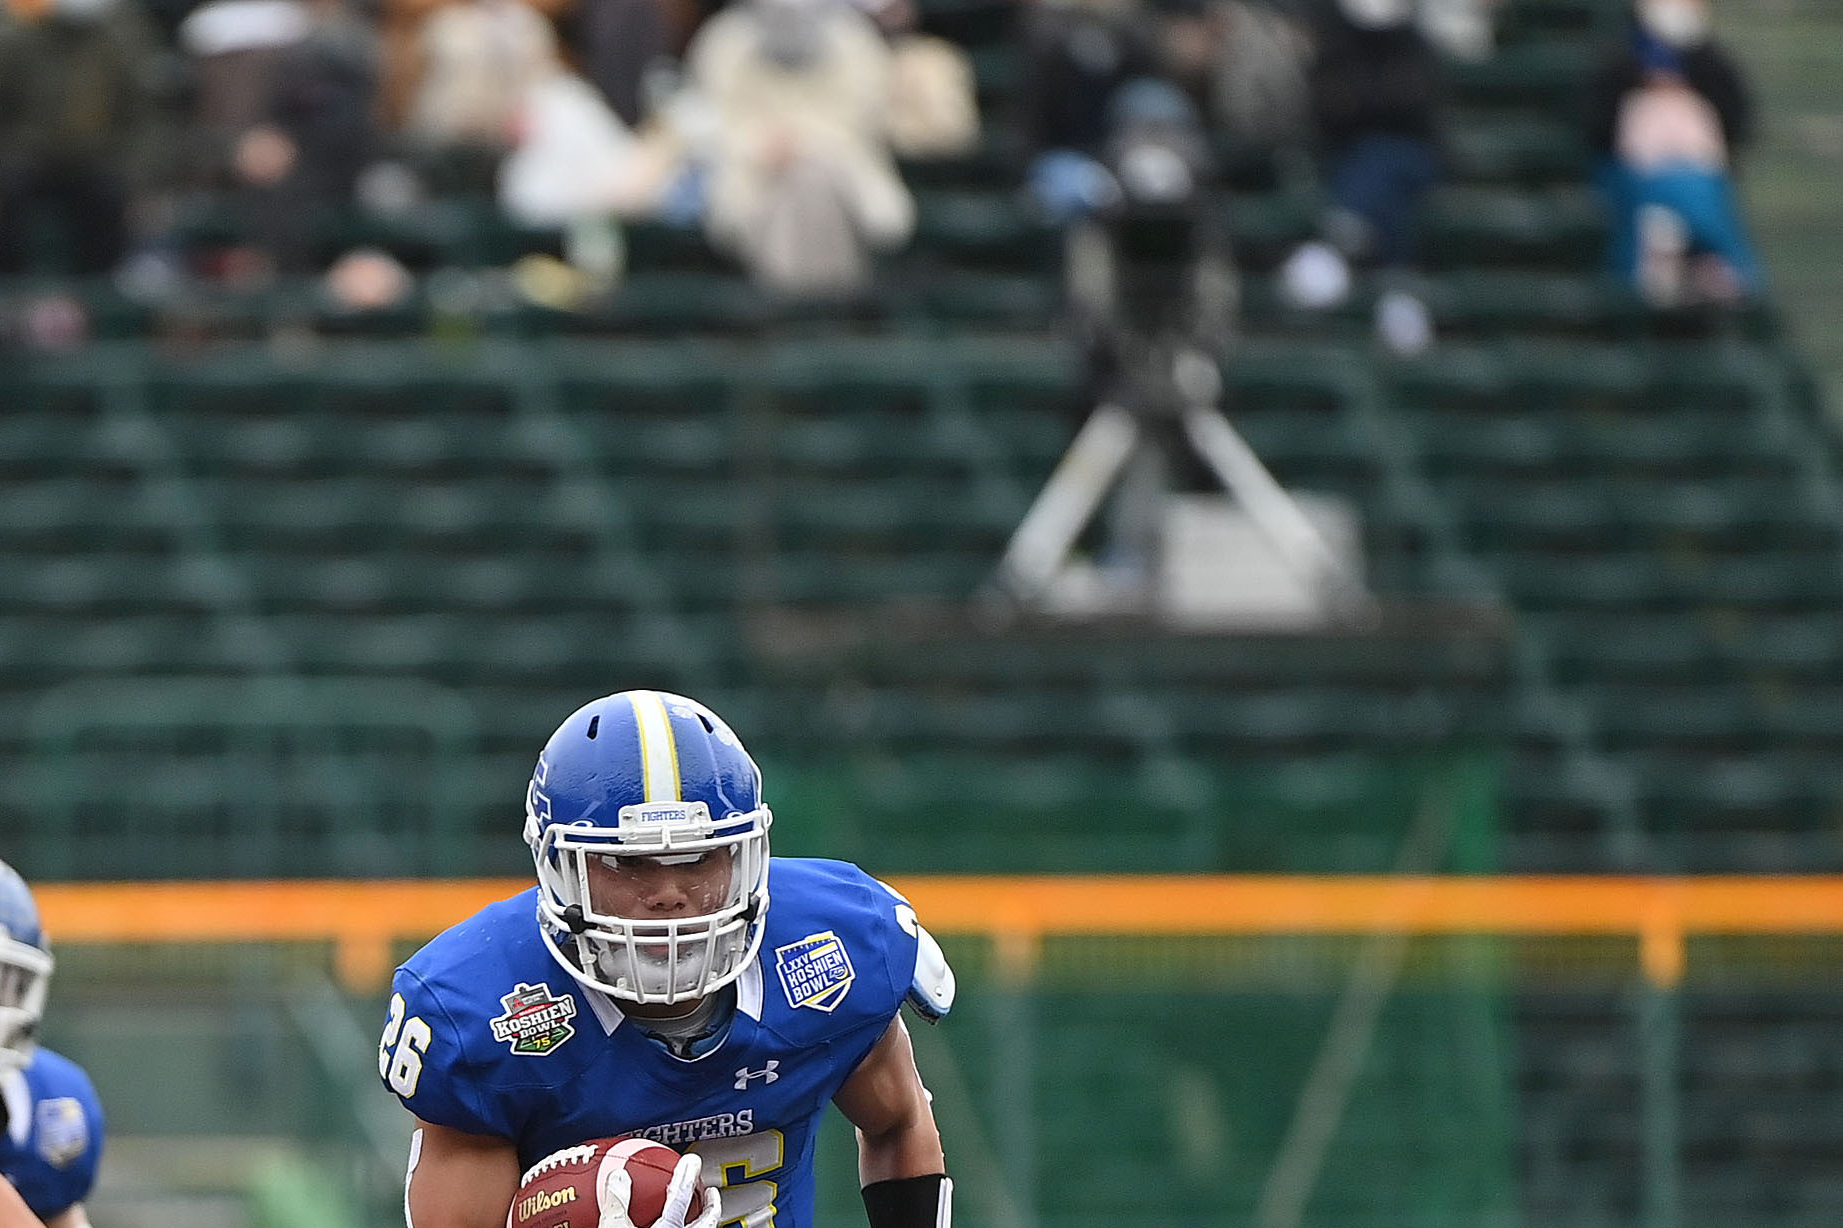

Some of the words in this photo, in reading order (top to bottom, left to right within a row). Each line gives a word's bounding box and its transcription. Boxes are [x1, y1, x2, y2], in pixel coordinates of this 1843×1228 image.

[641, 809, 687, 823] FIGHTERS
[782, 953, 810, 974] LXXV
[787, 950, 845, 989] KOSHIEN
[791, 972, 834, 1002] BOWL
[495, 998, 573, 1038] KOSHIEN
[520, 1020, 561, 1039] BOWL
[379, 992, 432, 1099] 26
[533, 1036, 551, 1049] 75
[618, 1109, 754, 1144] GHTERS
[518, 1186, 576, 1222] Wilson
